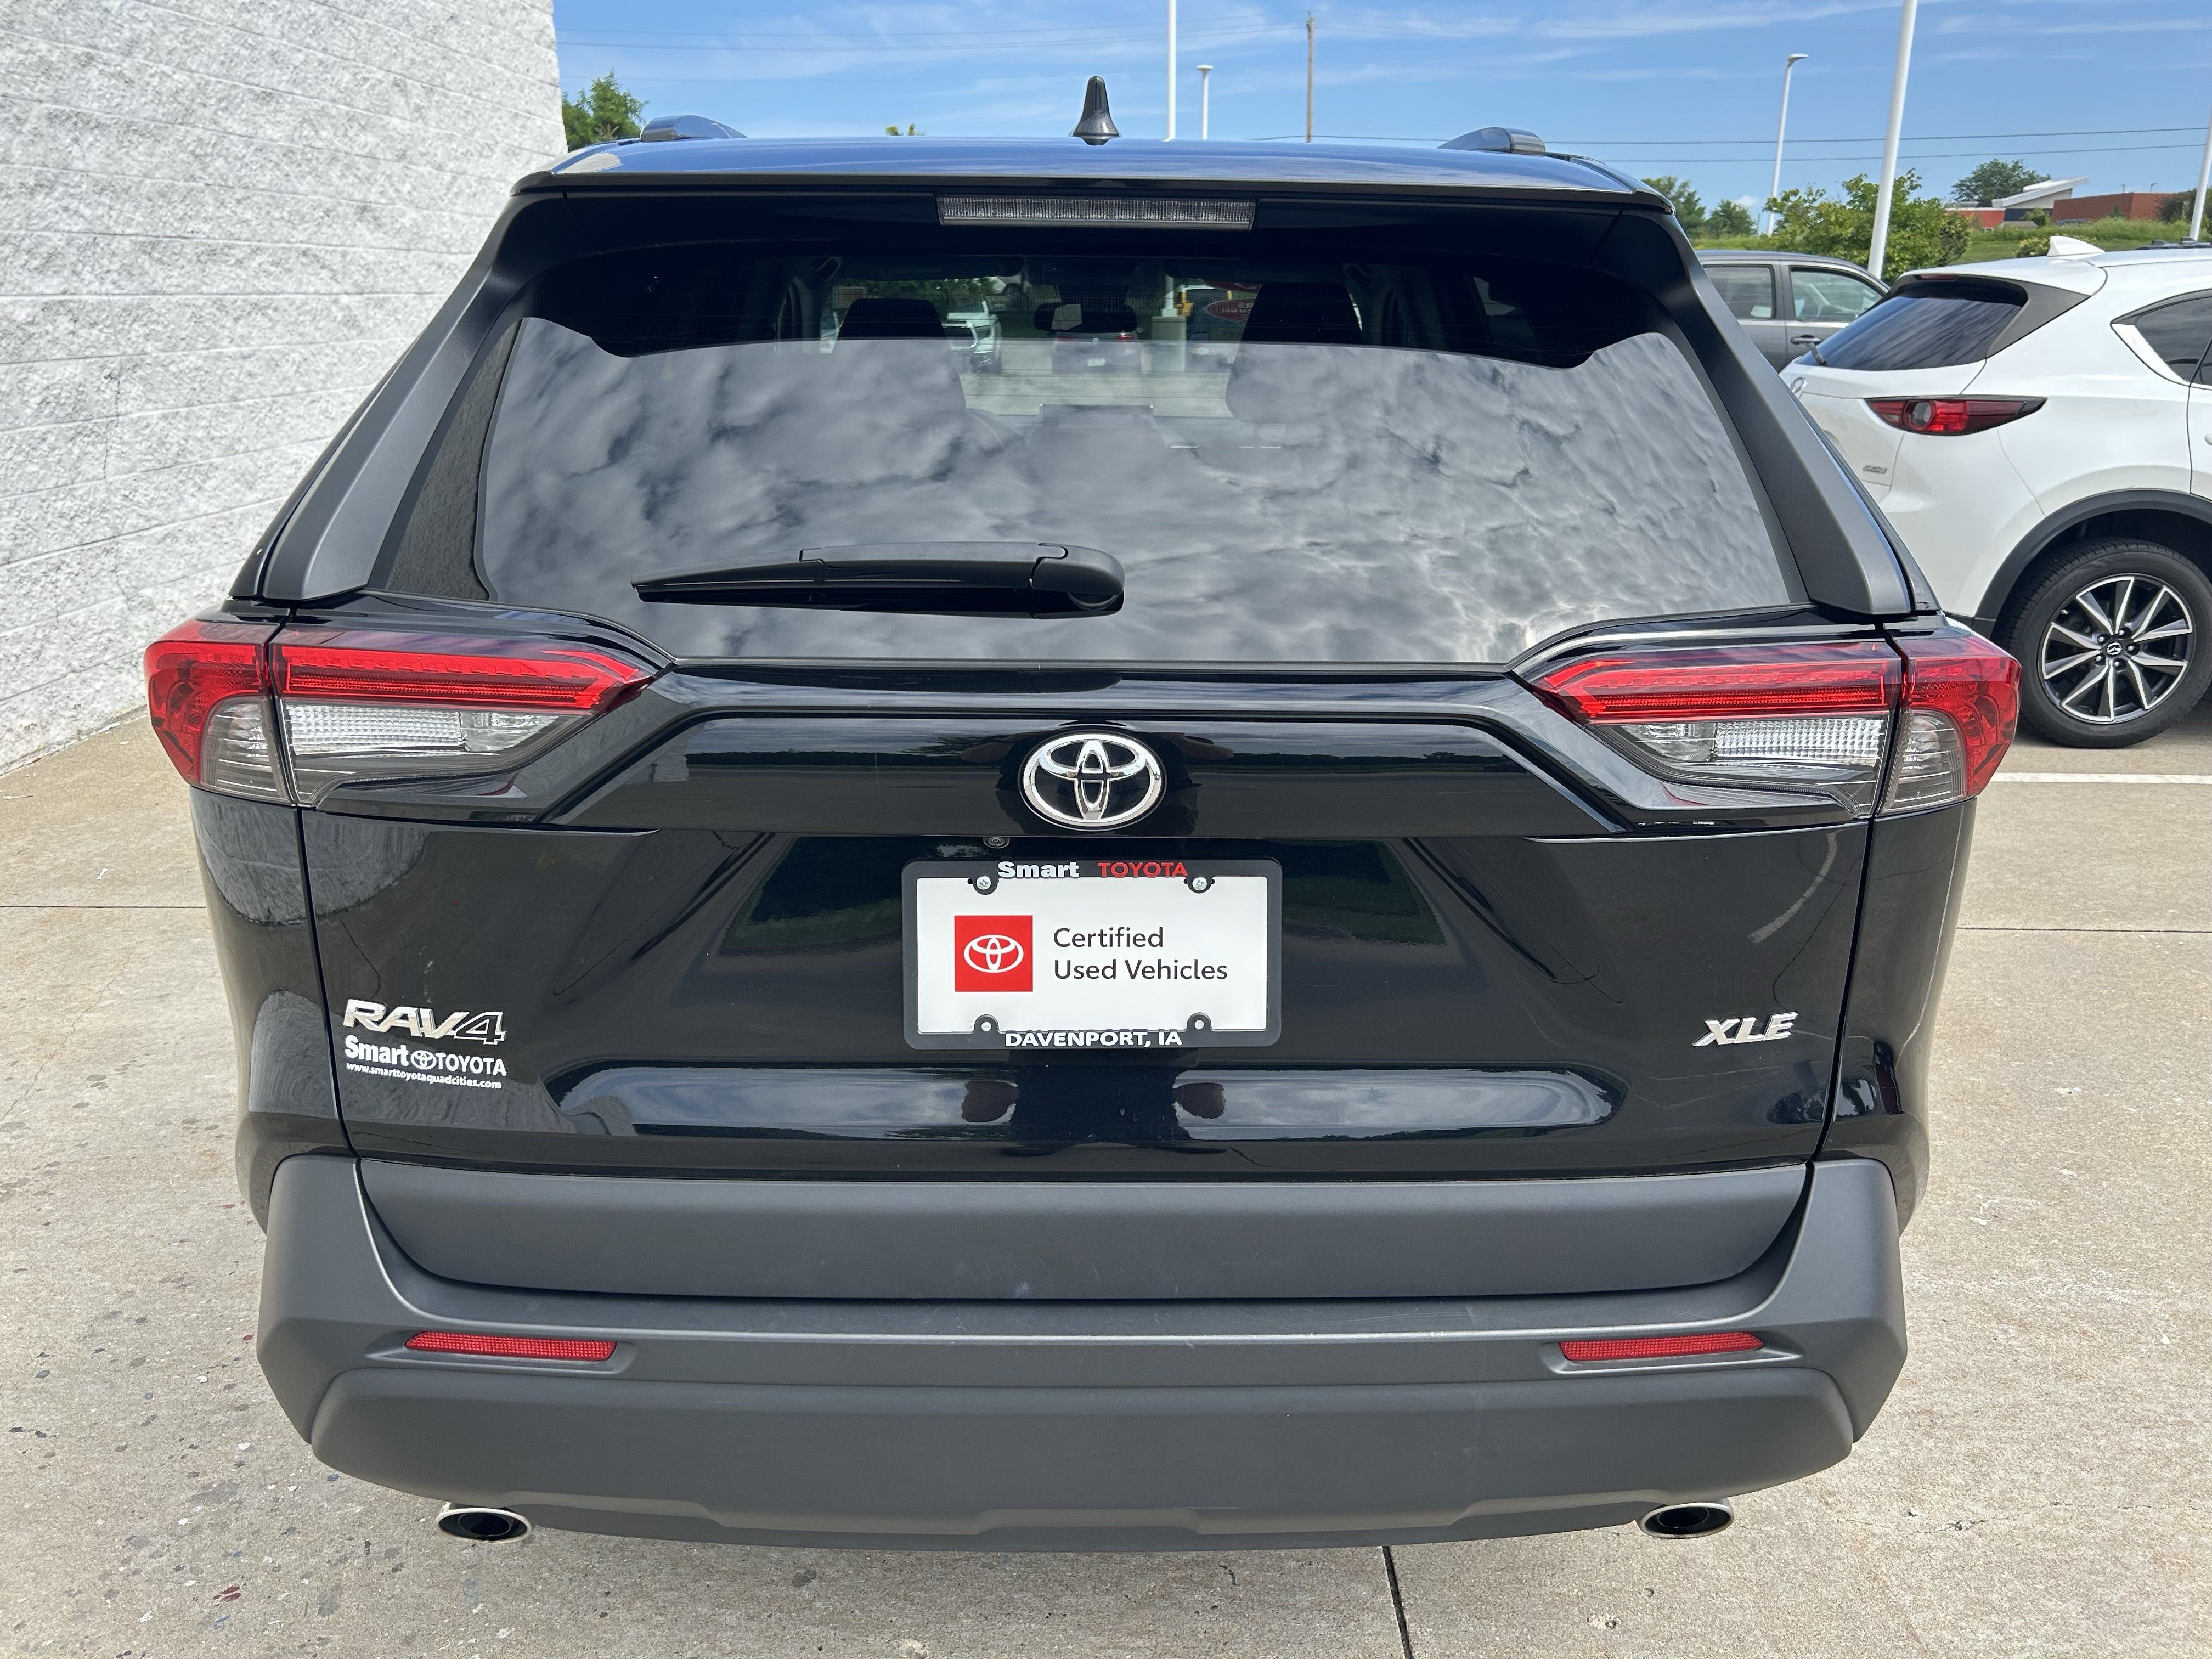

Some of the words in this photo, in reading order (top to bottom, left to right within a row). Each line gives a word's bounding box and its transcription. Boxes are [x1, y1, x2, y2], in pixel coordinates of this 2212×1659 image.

[998, 861, 1079, 878] Smart
[1097, 861, 1188, 878] TOYOTA
[1053, 927, 1164, 948] Certified
[1054, 959, 1117, 980] Used
[1125, 959, 1228, 980] Vehicles
[343, 998, 507, 1045] RAV4
[1692, 1012, 1798, 1047] XLE
[1005, 1031, 1152, 1048] DAVENPORT,
[1158, 1030, 1182, 1046] IA
[345, 1035, 409, 1066] Smart
[436, 1052, 507, 1076] TOYOTA
[346, 1062, 502, 1090] www.smarttoyotaquadcities.com
